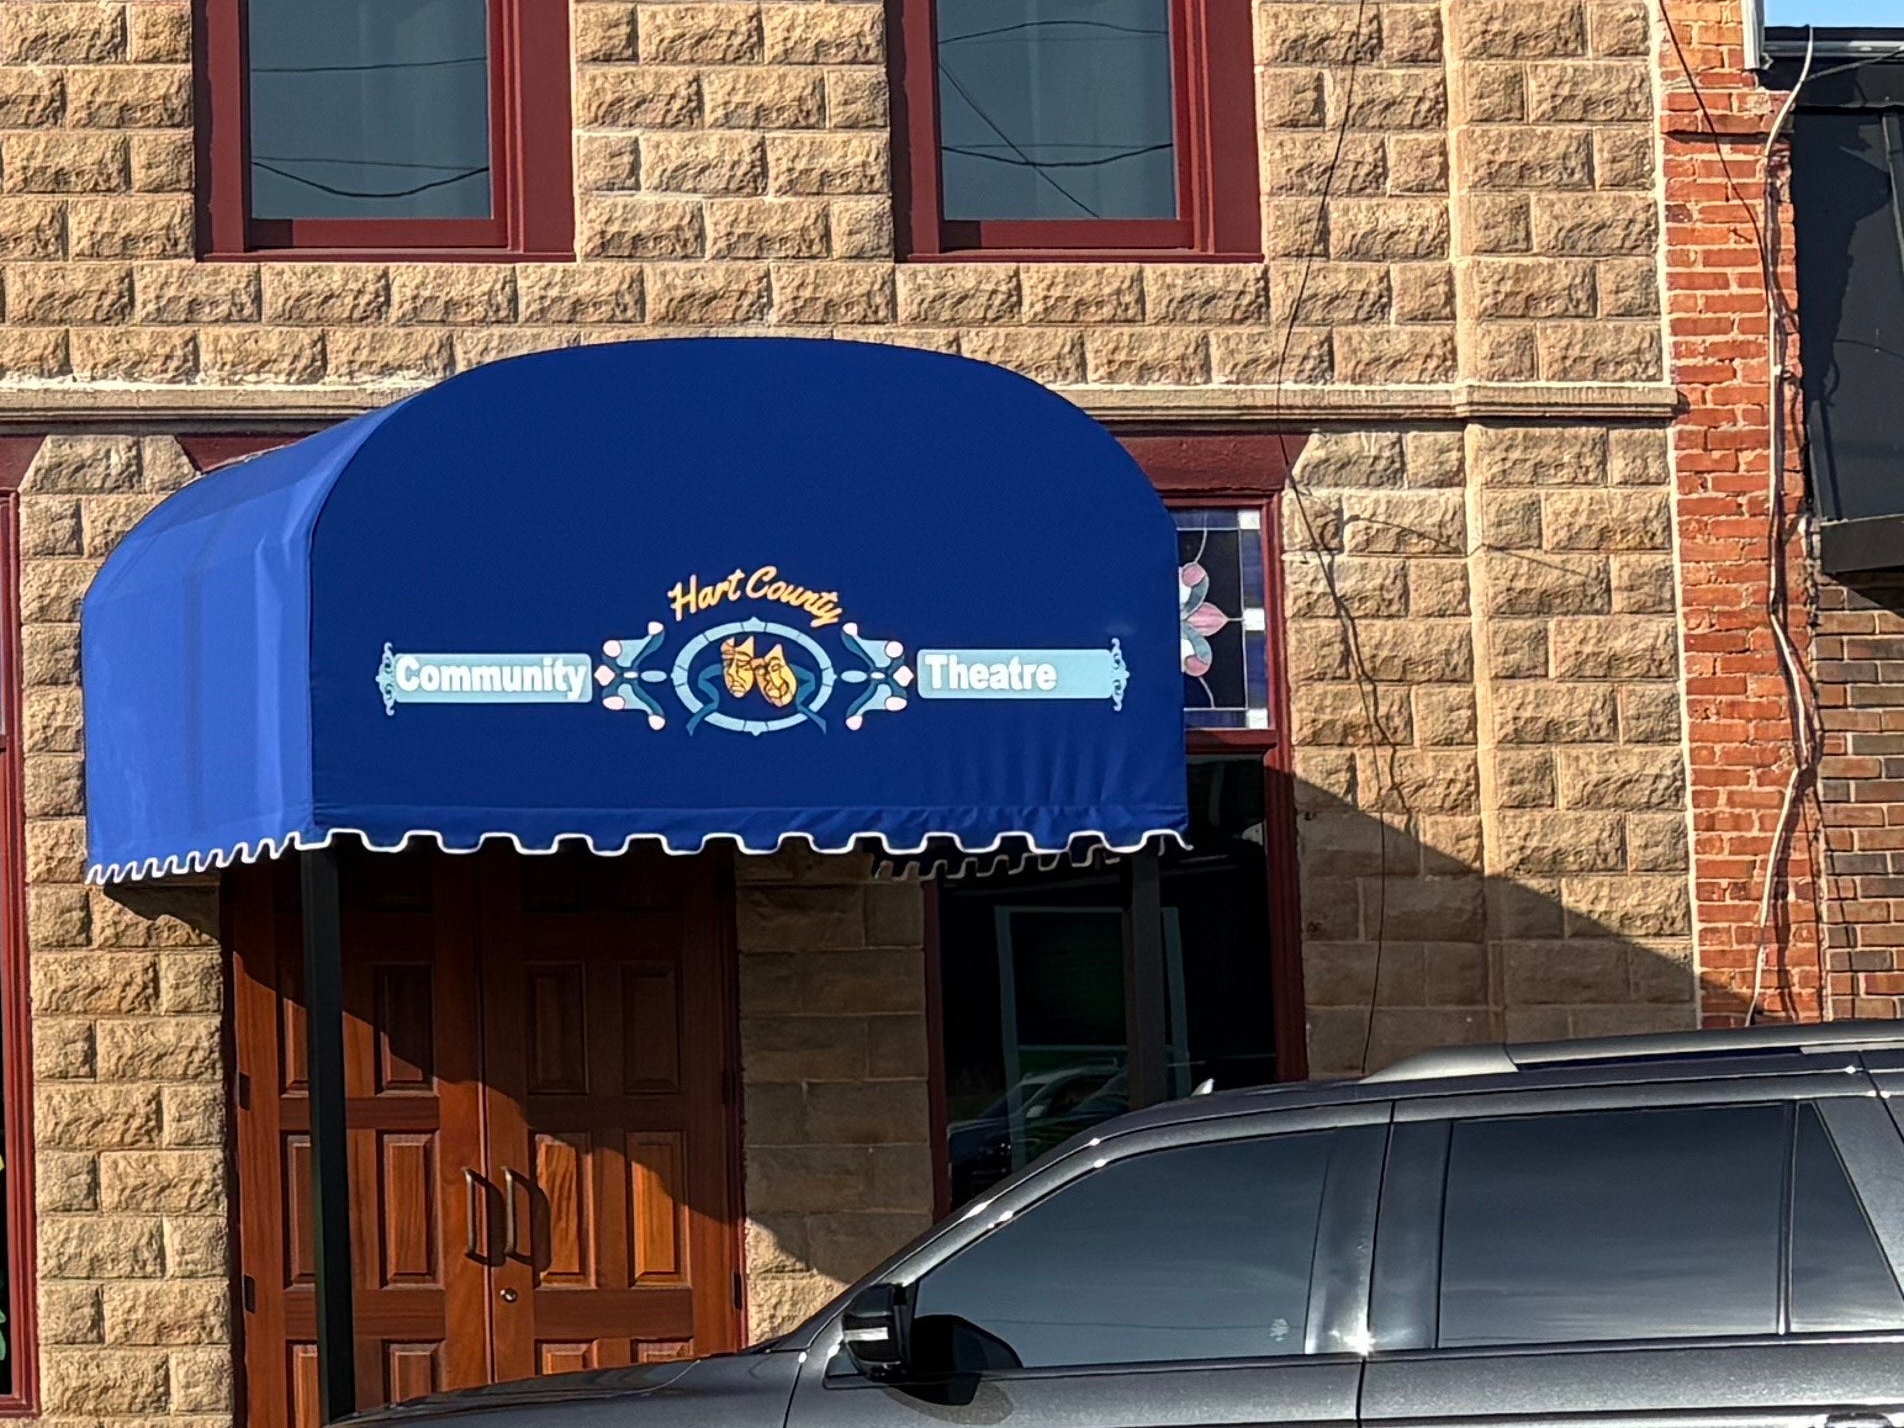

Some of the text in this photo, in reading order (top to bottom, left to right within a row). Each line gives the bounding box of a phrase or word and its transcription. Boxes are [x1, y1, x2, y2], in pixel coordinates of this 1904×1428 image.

[667, 564, 845, 628] Hart County
[394, 653, 1057, 700] Community Theatre
